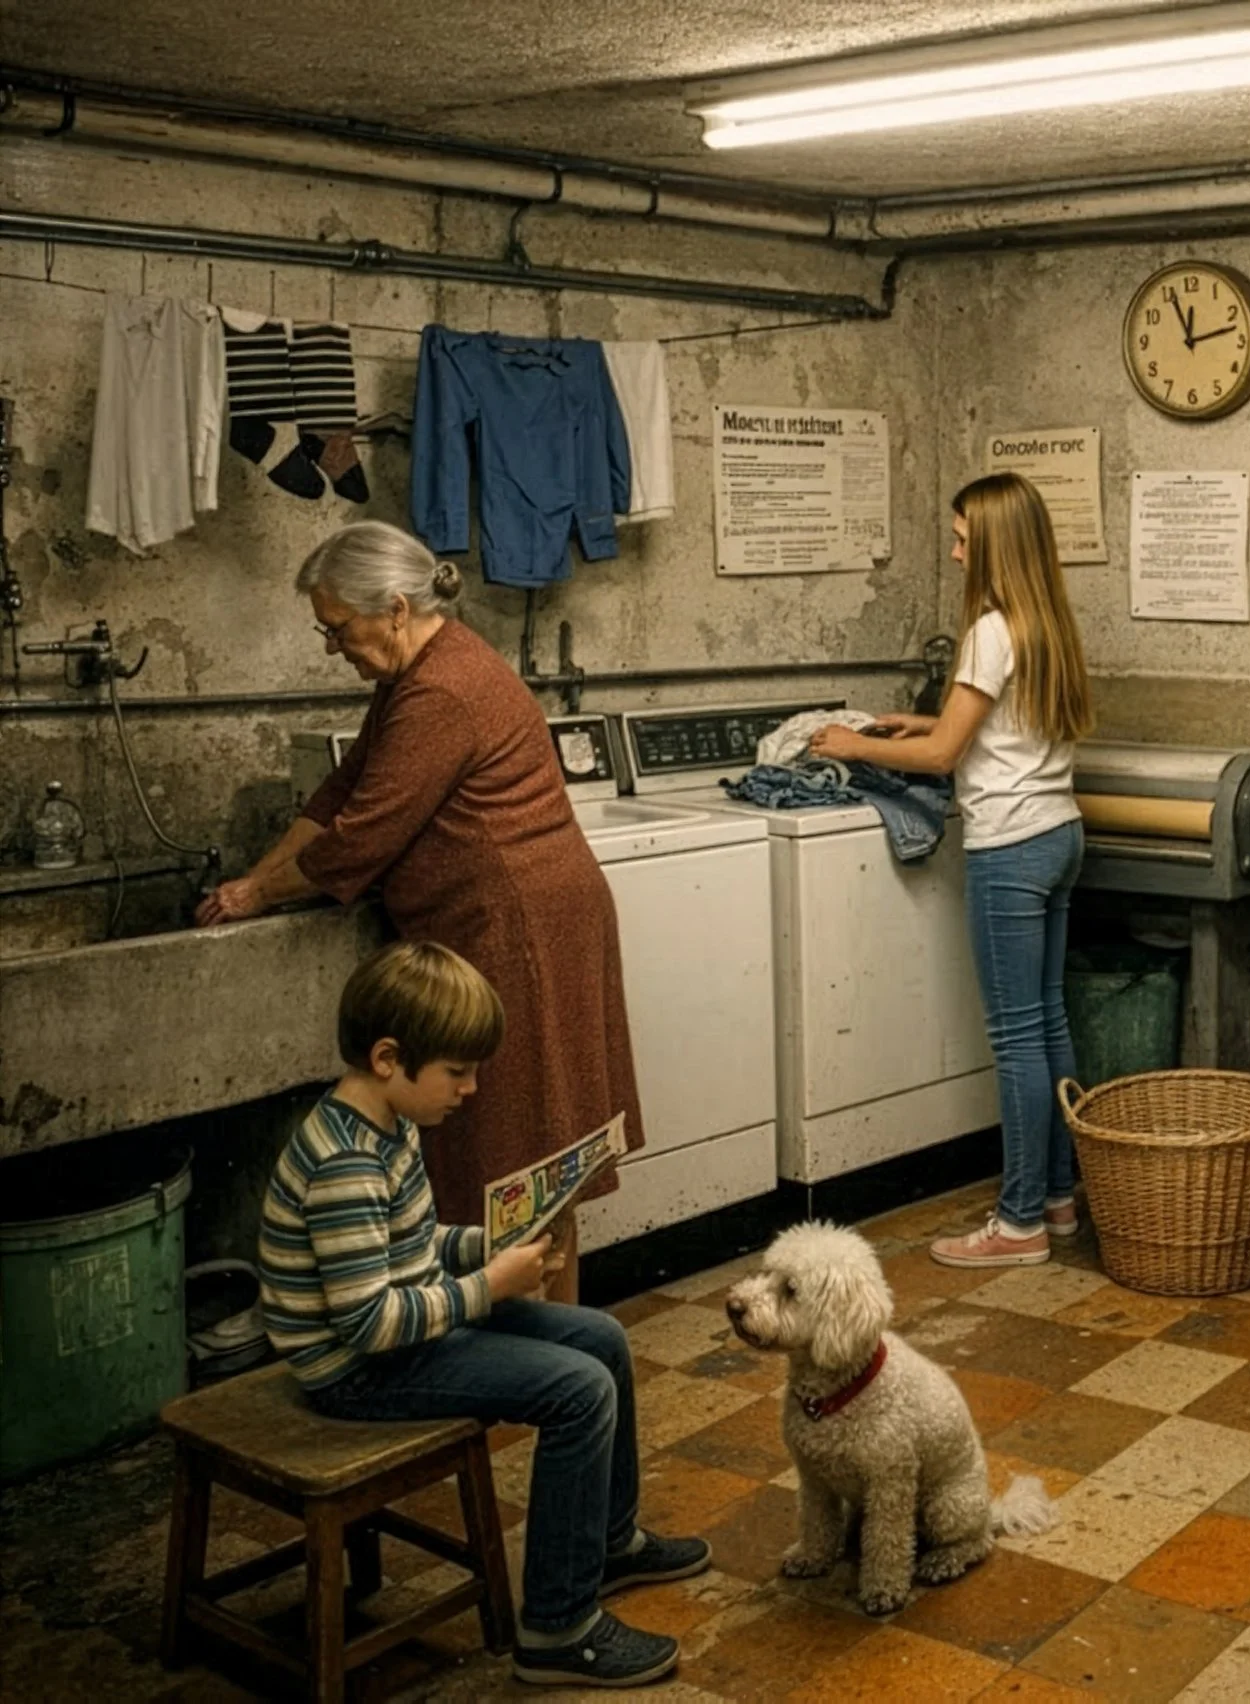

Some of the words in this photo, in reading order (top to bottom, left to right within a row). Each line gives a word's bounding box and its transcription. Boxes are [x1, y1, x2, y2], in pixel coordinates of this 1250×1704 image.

[1183, 276, 1199, 293] 12
[1146, 309, 1160, 325] 10
[1227, 305, 1238, 322] 2
[1139, 334, 1149, 350] 9
[1237, 335, 1246, 349] 3
[1163, 380, 1174, 400] 7
[1213, 381, 1222, 396] 5
[1187, 389, 1198, 405] 6
